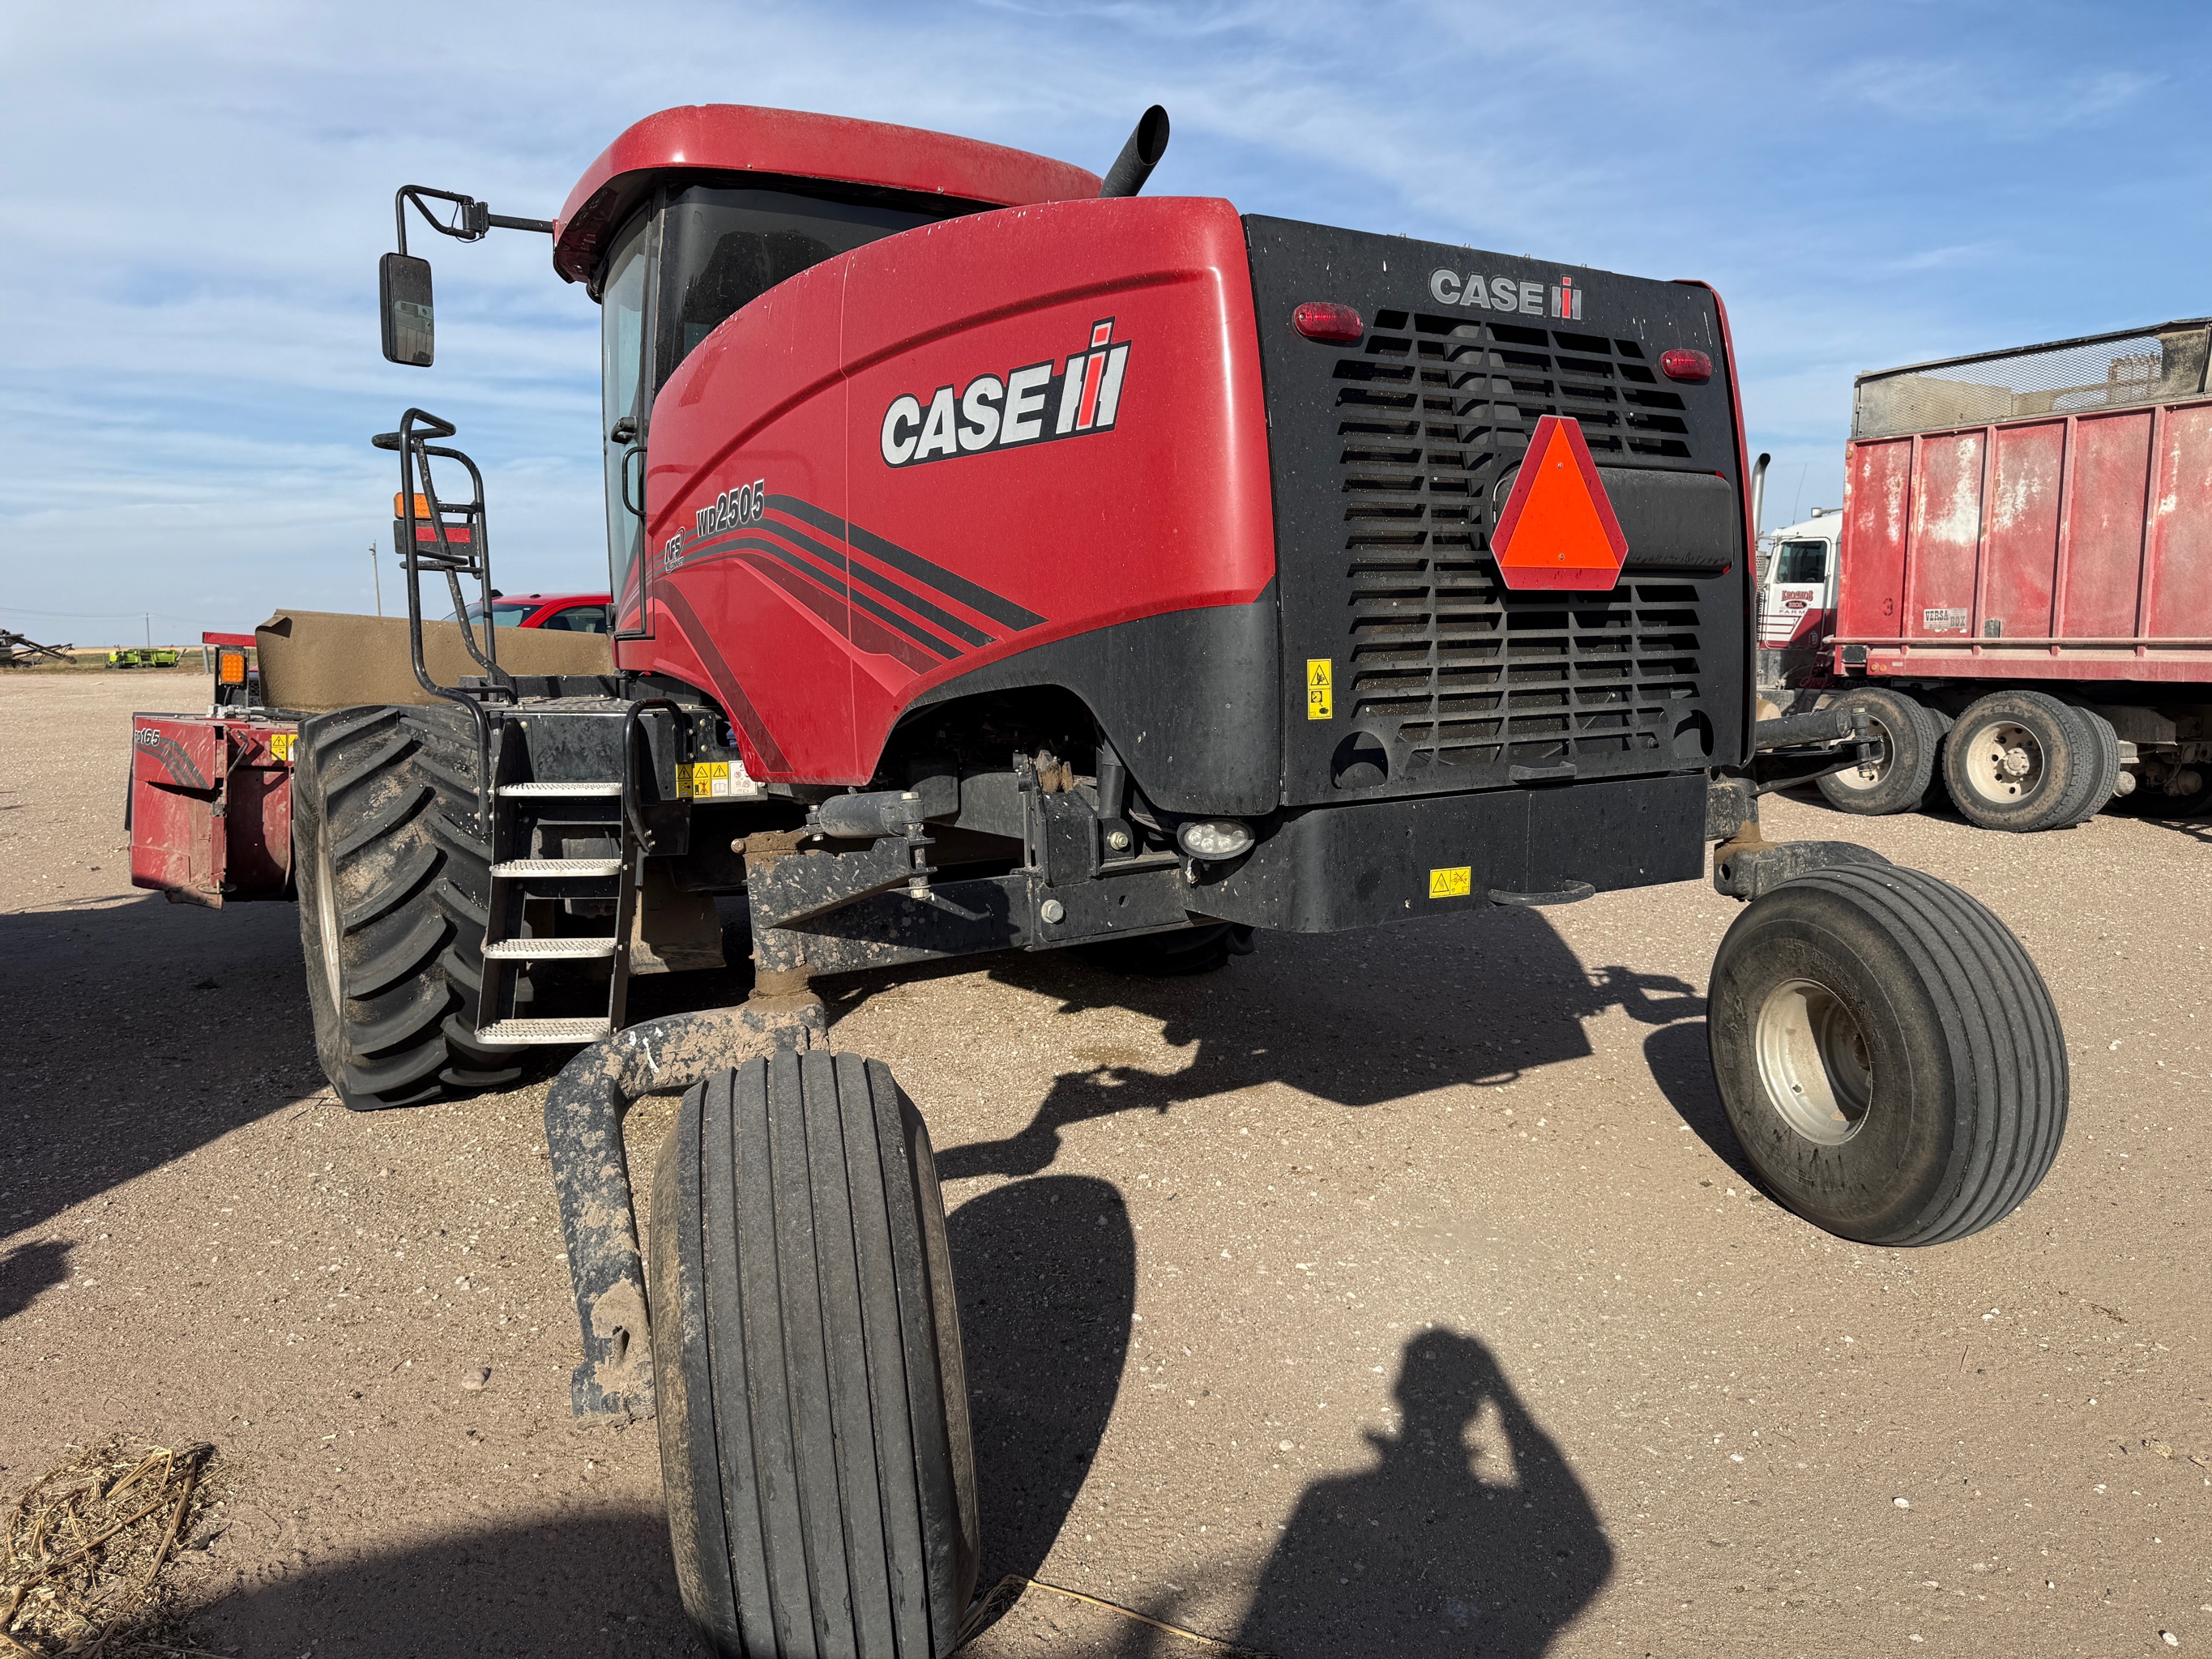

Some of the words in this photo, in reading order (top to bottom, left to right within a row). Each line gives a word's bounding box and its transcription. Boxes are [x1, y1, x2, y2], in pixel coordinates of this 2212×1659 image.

[1430, 268, 1544, 315] CASE
[881, 364, 1053, 465] CASE
[696, 476, 765, 539] WD2505
[664, 533, 682, 565] AFS
[1882, 597, 1894, 616] 3
[1925, 610, 1949, 621] VERSA
[1949, 616, 1966, 627] BOX
